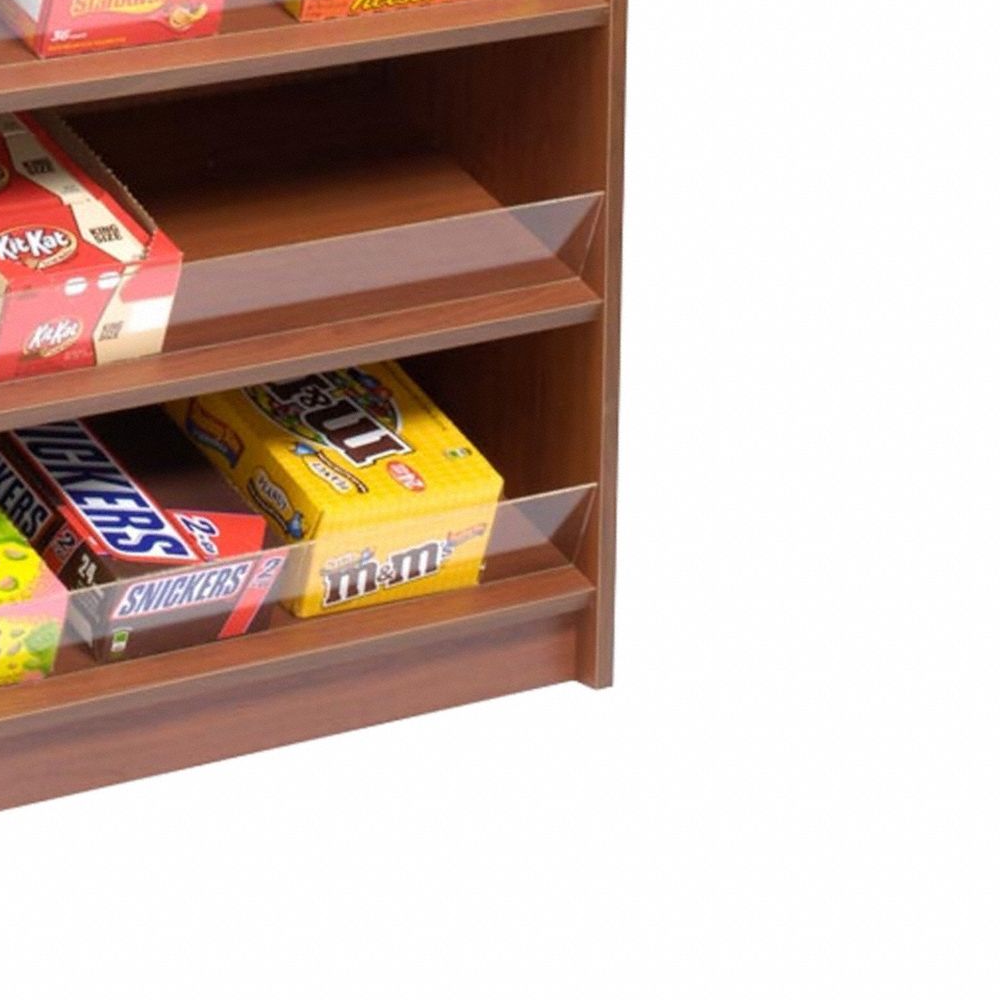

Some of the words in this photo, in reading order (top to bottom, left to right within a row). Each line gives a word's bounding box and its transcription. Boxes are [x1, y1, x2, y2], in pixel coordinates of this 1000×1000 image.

[13, 421, 191, 558] ICKERS
[119, 563, 250, 616] SNICKERS
[257, 557, 281, 580] 2
